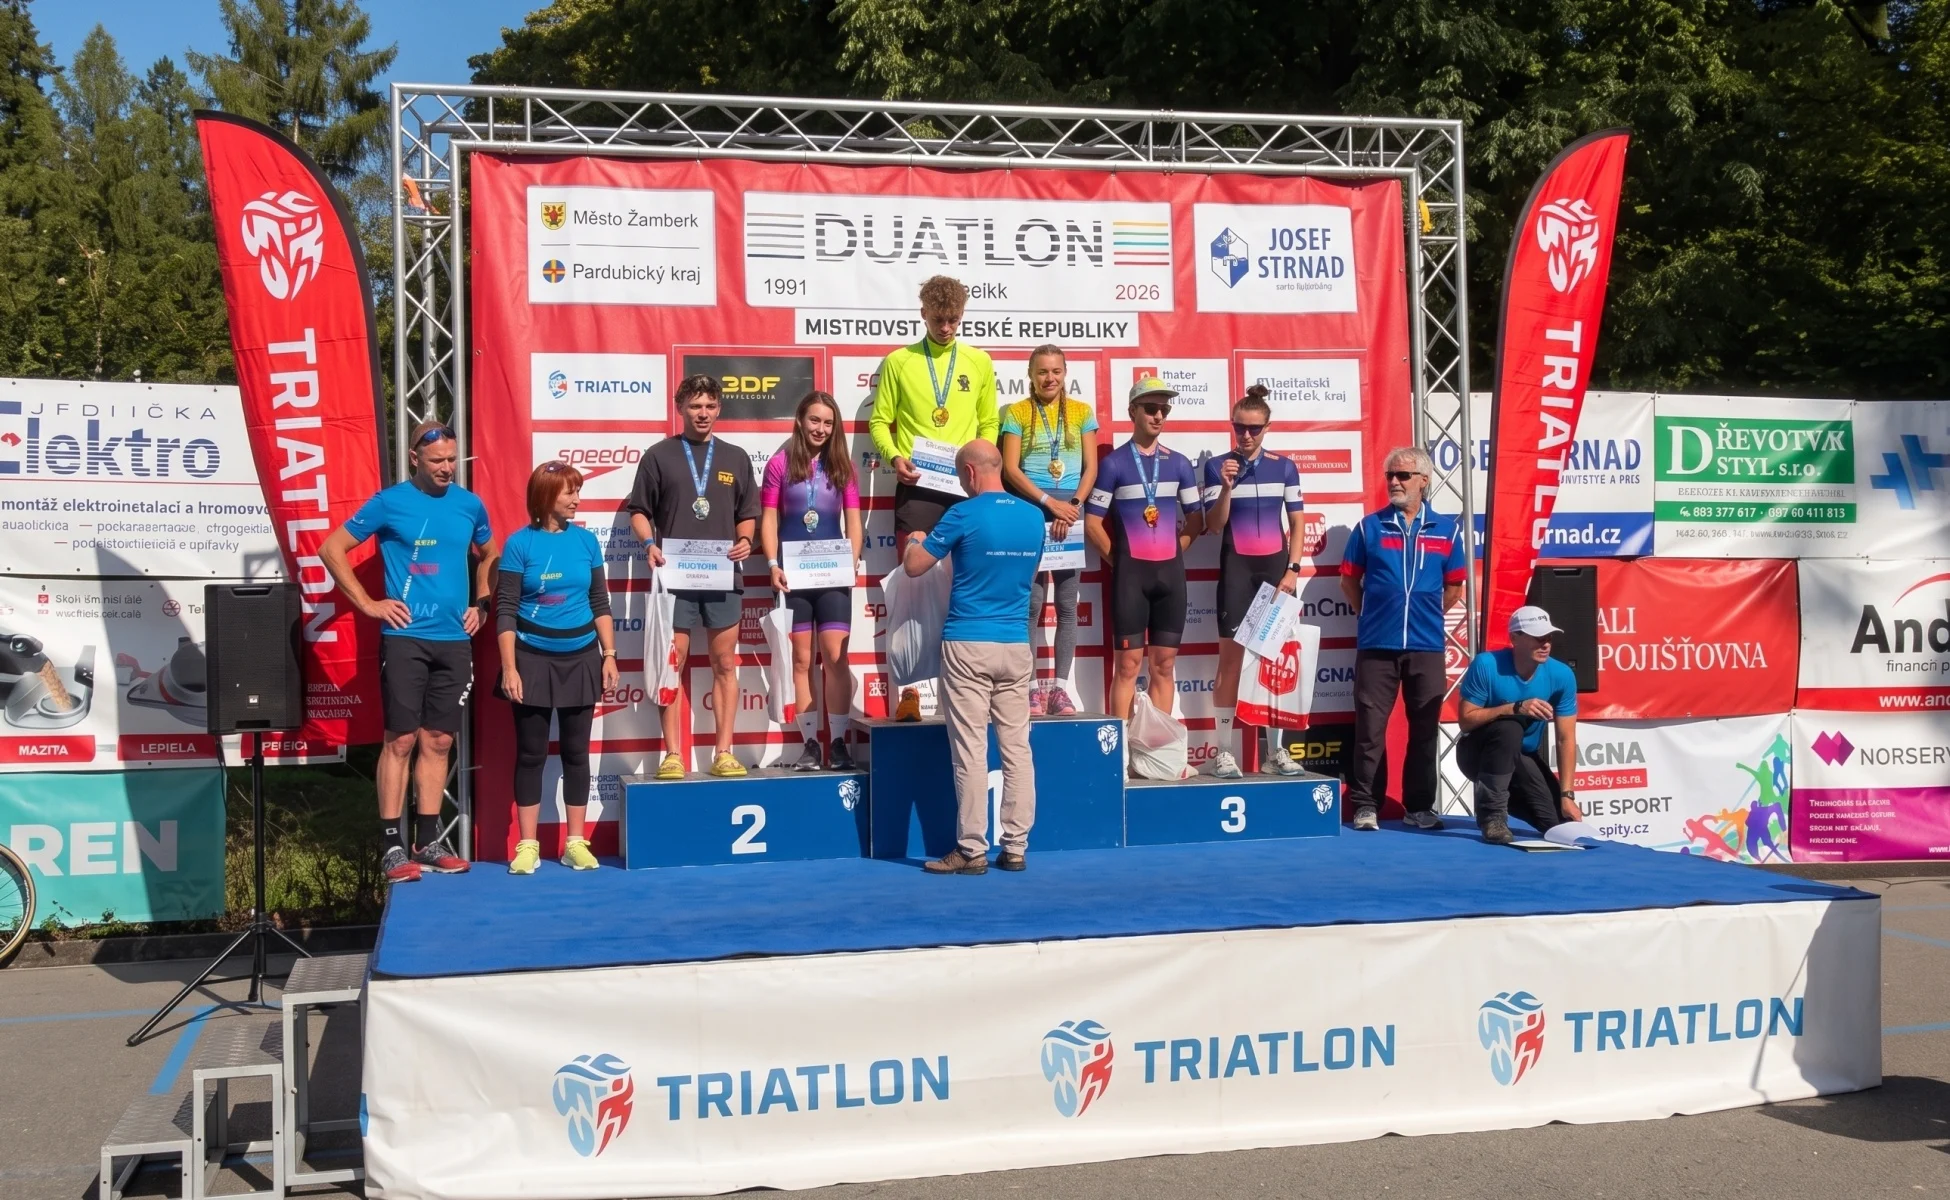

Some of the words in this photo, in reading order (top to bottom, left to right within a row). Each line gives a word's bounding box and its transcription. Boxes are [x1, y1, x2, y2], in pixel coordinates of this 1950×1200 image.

[573, 209, 623, 228] Město
[627, 207, 699, 229] Žamberk
[815, 212, 1103, 268] DUATLON
[1268, 227, 1332, 251] JOSEF
[572, 263, 666, 284] Pardubický
[670, 264, 702, 285] kraj
[1257, 255, 1345, 279] STRNAD
[764, 278, 807, 296] 1991
[1115, 283, 1160, 300] 2026
[1019, 321, 1128, 339] REPUBLIKY
[574, 380, 652, 394] TRIATLON
[558, 445, 641, 468] speedo
[1523, 319, 1583, 596] TRIATLO
[1562, 439, 1641, 471] RNAD
[1717, 456, 1774, 477] STYL
[185, 504, 194, 514] a
[1715, 507, 1735, 518] 377
[1737, 507, 1756, 518] 617
[1791, 507, 1804, 518] 60
[1806, 507, 1824, 518] 411
[1827, 507, 1846, 518] 813
[1597, 636, 1769, 673] POJIŠŤOVNA
[1316, 667, 1356, 683] GNA
[601, 684, 644, 704] edo
[140, 742, 197, 754] LEPIELA
[1187, 741, 1219, 760] edo
[1220, 796, 1247, 833] 3
[1609, 796, 1673, 815] SPORT
[731, 803, 768, 855] 2
[10, 820, 179, 877] REN
[1564, 996, 1803, 1053] TRIATLON
[1134, 1023, 1396, 1084] TRIATLON
[657, 1055, 950, 1122] TRIATLON
